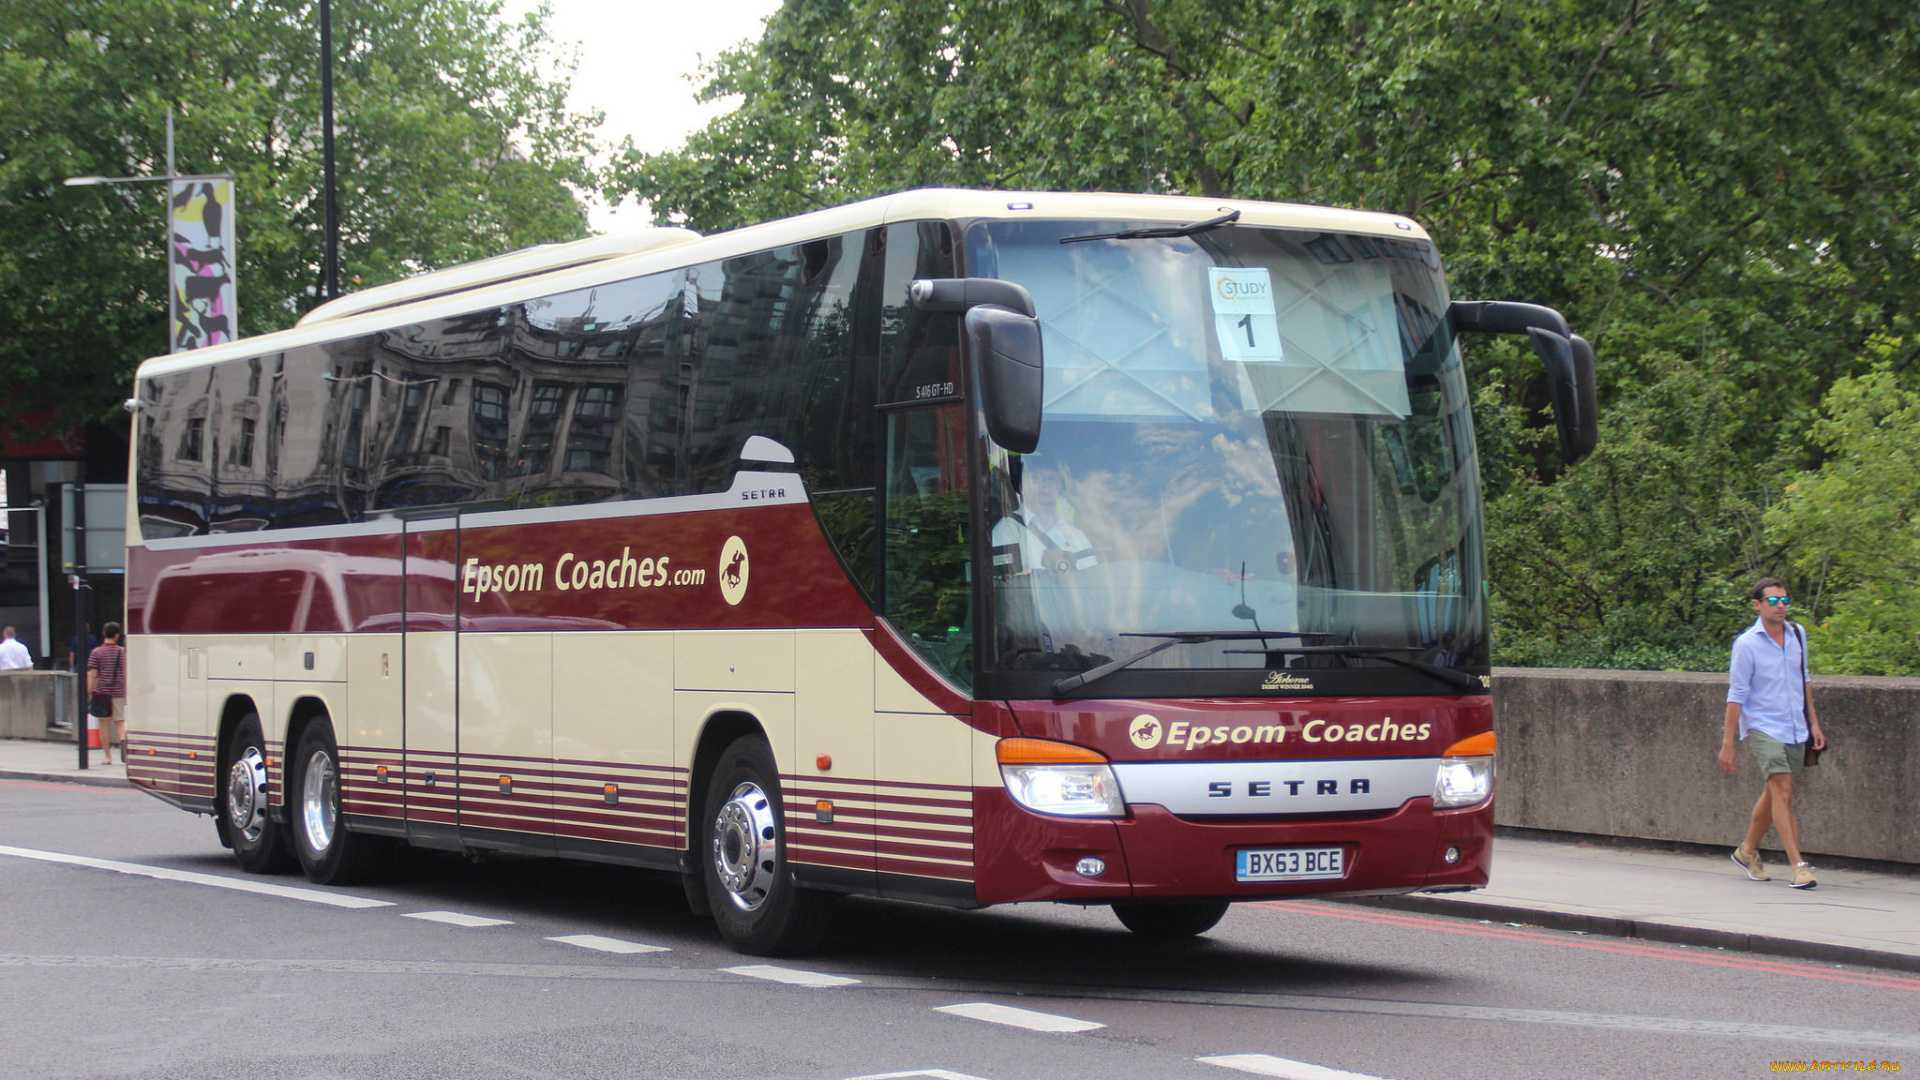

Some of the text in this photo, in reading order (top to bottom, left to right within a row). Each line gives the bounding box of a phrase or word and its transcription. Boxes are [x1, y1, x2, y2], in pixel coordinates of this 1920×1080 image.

[1225, 282, 1267, 294] STUDY
[1238, 313, 1256, 348] 1
[741, 488, 785, 501] SETRA
[463, 546, 706, 603] Epsom Coaches.com
[1264, 670, 1310, 684] Airborne
[1166, 717, 1431, 751] Epsom Coaches
[1208, 779, 1370, 798] SETRA
[1249, 850, 1341, 874] BX63 BCE
